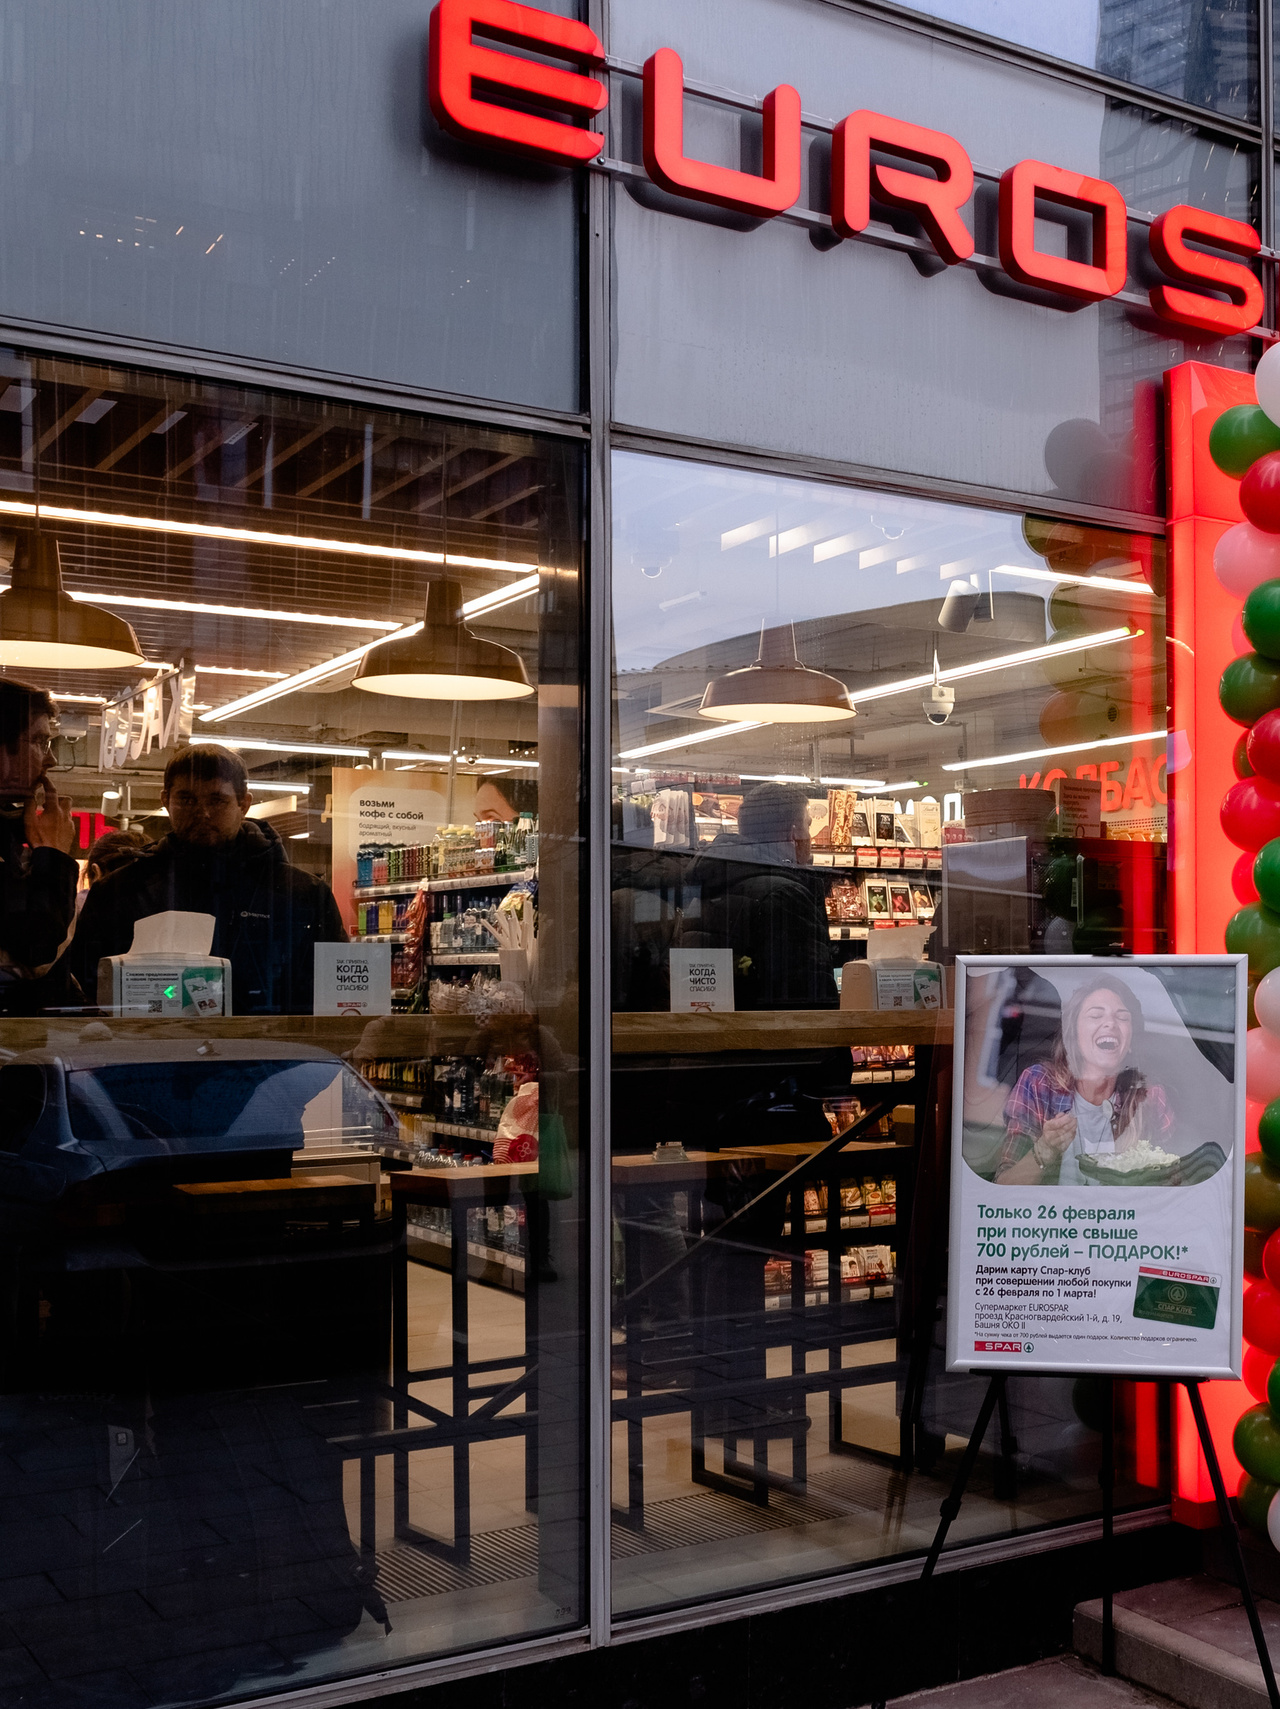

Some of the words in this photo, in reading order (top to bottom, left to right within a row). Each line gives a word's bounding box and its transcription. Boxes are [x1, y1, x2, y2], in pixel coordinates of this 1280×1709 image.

[359, 800, 395, 808] возьми
[359, 810, 385, 820] кофе
[396, 811, 424, 820] собой
[336, 965, 369, 974] КОГДА
[689, 969, 716, 977] КОГДА
[336, 975, 369, 983] ЧИСТО
[977, 1205, 1032, 1219] Только
[1037, 1205, 1058, 1219] 26
[1062, 1205, 1135, 1223] февраля
[977, 1227, 1006, 1241] при
[1012, 1227, 1078, 1242] покупке
[1083, 1228, 1138, 1240] свыше
[976, 1243, 1006, 1257] 700
[1011, 1244, 1069, 1261] рублей
[975, 1265, 1008, 1275] Дарим
[1011, 1267, 1038, 1276] карту
[1040, 1266, 1091, 1277] Спар-клуб
[1162, 1270, 1209, 1282] EUROSPAR
[976, 1277, 993, 1286] при
[995, 1278, 1055, 1287] совершении
[1057, 1278, 1089, 1287] любой
[1092, 1280, 1131, 1289] покупки
[983, 1287, 995, 1296] 26
[997, 1288, 1040, 1298] февраля
[1057, 1288, 1061, 1297] 1
[1063, 1289, 1096, 1300] марта!
[975, 1302, 1027, 1312] Супермаркет
[1028, 1303, 1069, 1312] EUROSPAR
[1158, 1303, 1175, 1311] СПАР
[1176, 1306, 1192, 1314] КЛУБ
[975, 1312, 1003, 1321] проезд
[1004, 1312, 1084, 1322] Красногвардейский
[1086, 1314, 1100, 1323] 1-й,
[1102, 1315, 1109, 1323] д.
[1112, 1314, 1122, 1323] 19,
[975, 1321, 1000, 1329] Башня
[1002, 1321, 1020, 1329] ОКО
[985, 1342, 1021, 1351] SPAR
